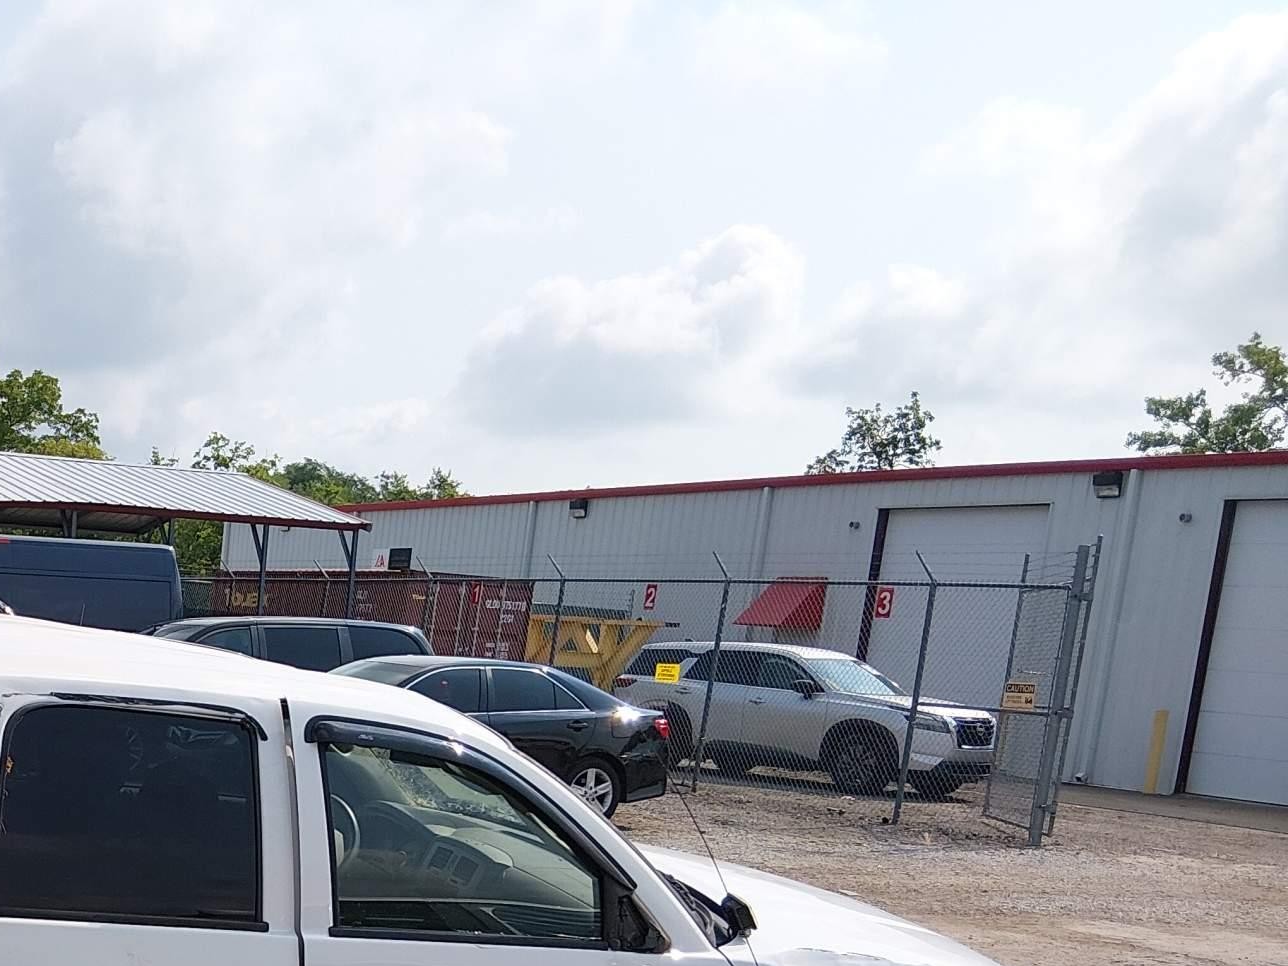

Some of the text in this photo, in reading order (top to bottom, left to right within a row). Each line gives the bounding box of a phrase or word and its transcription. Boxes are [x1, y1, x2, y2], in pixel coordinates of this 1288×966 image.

[473, 585, 481, 603] 1
[644, 587, 656, 608] 2
[878, 591, 891, 615] 3
[1006, 684, 1035, 693] CAUTION
